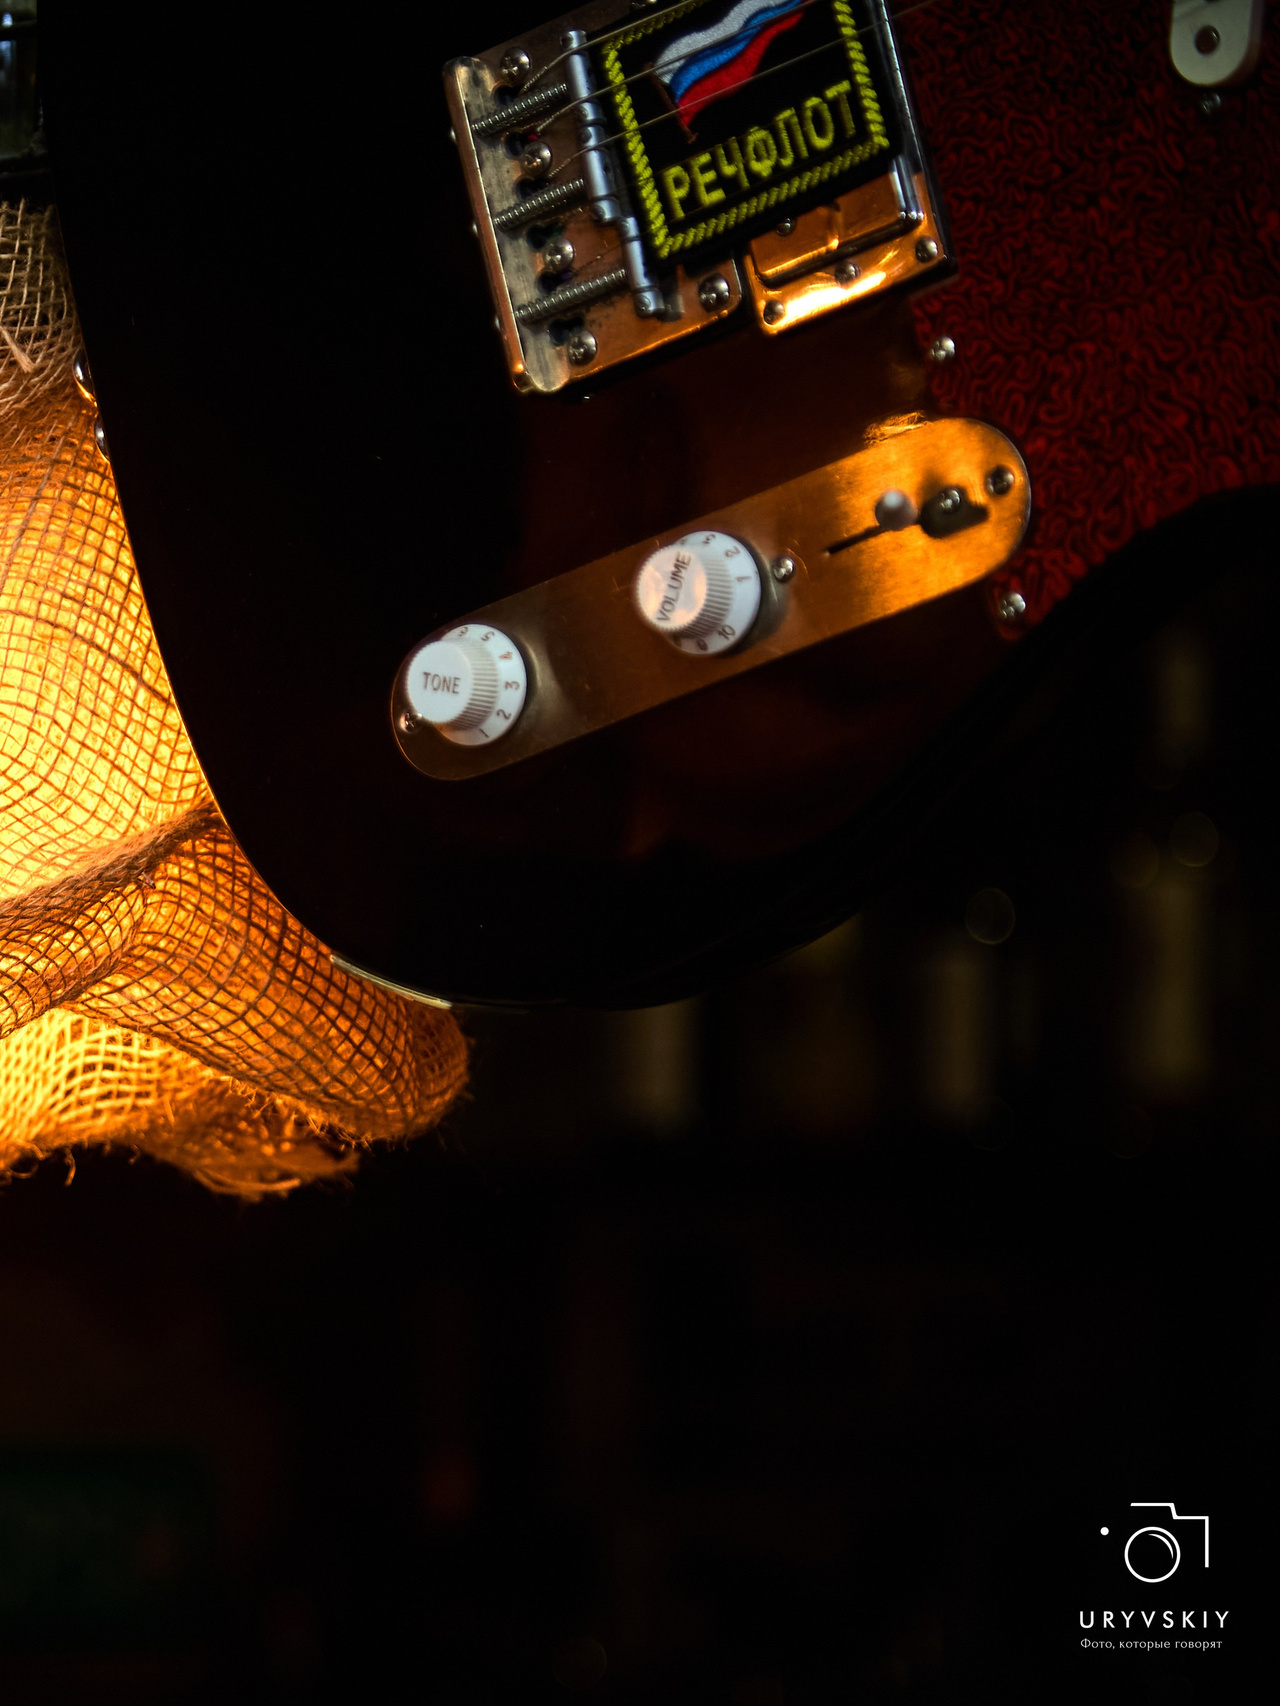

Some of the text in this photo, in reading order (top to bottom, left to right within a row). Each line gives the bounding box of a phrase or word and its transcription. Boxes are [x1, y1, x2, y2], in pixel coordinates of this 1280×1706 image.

[662, 79, 857, 220] РЕЧФЛОТ
[725, 546, 741, 558] 2
[656, 551, 692, 622] VOLUME
[718, 625, 736, 641] 10
[422, 671, 461, 695] TONE
[504, 680, 520, 691] 3
[496, 708, 512, 721] 2
